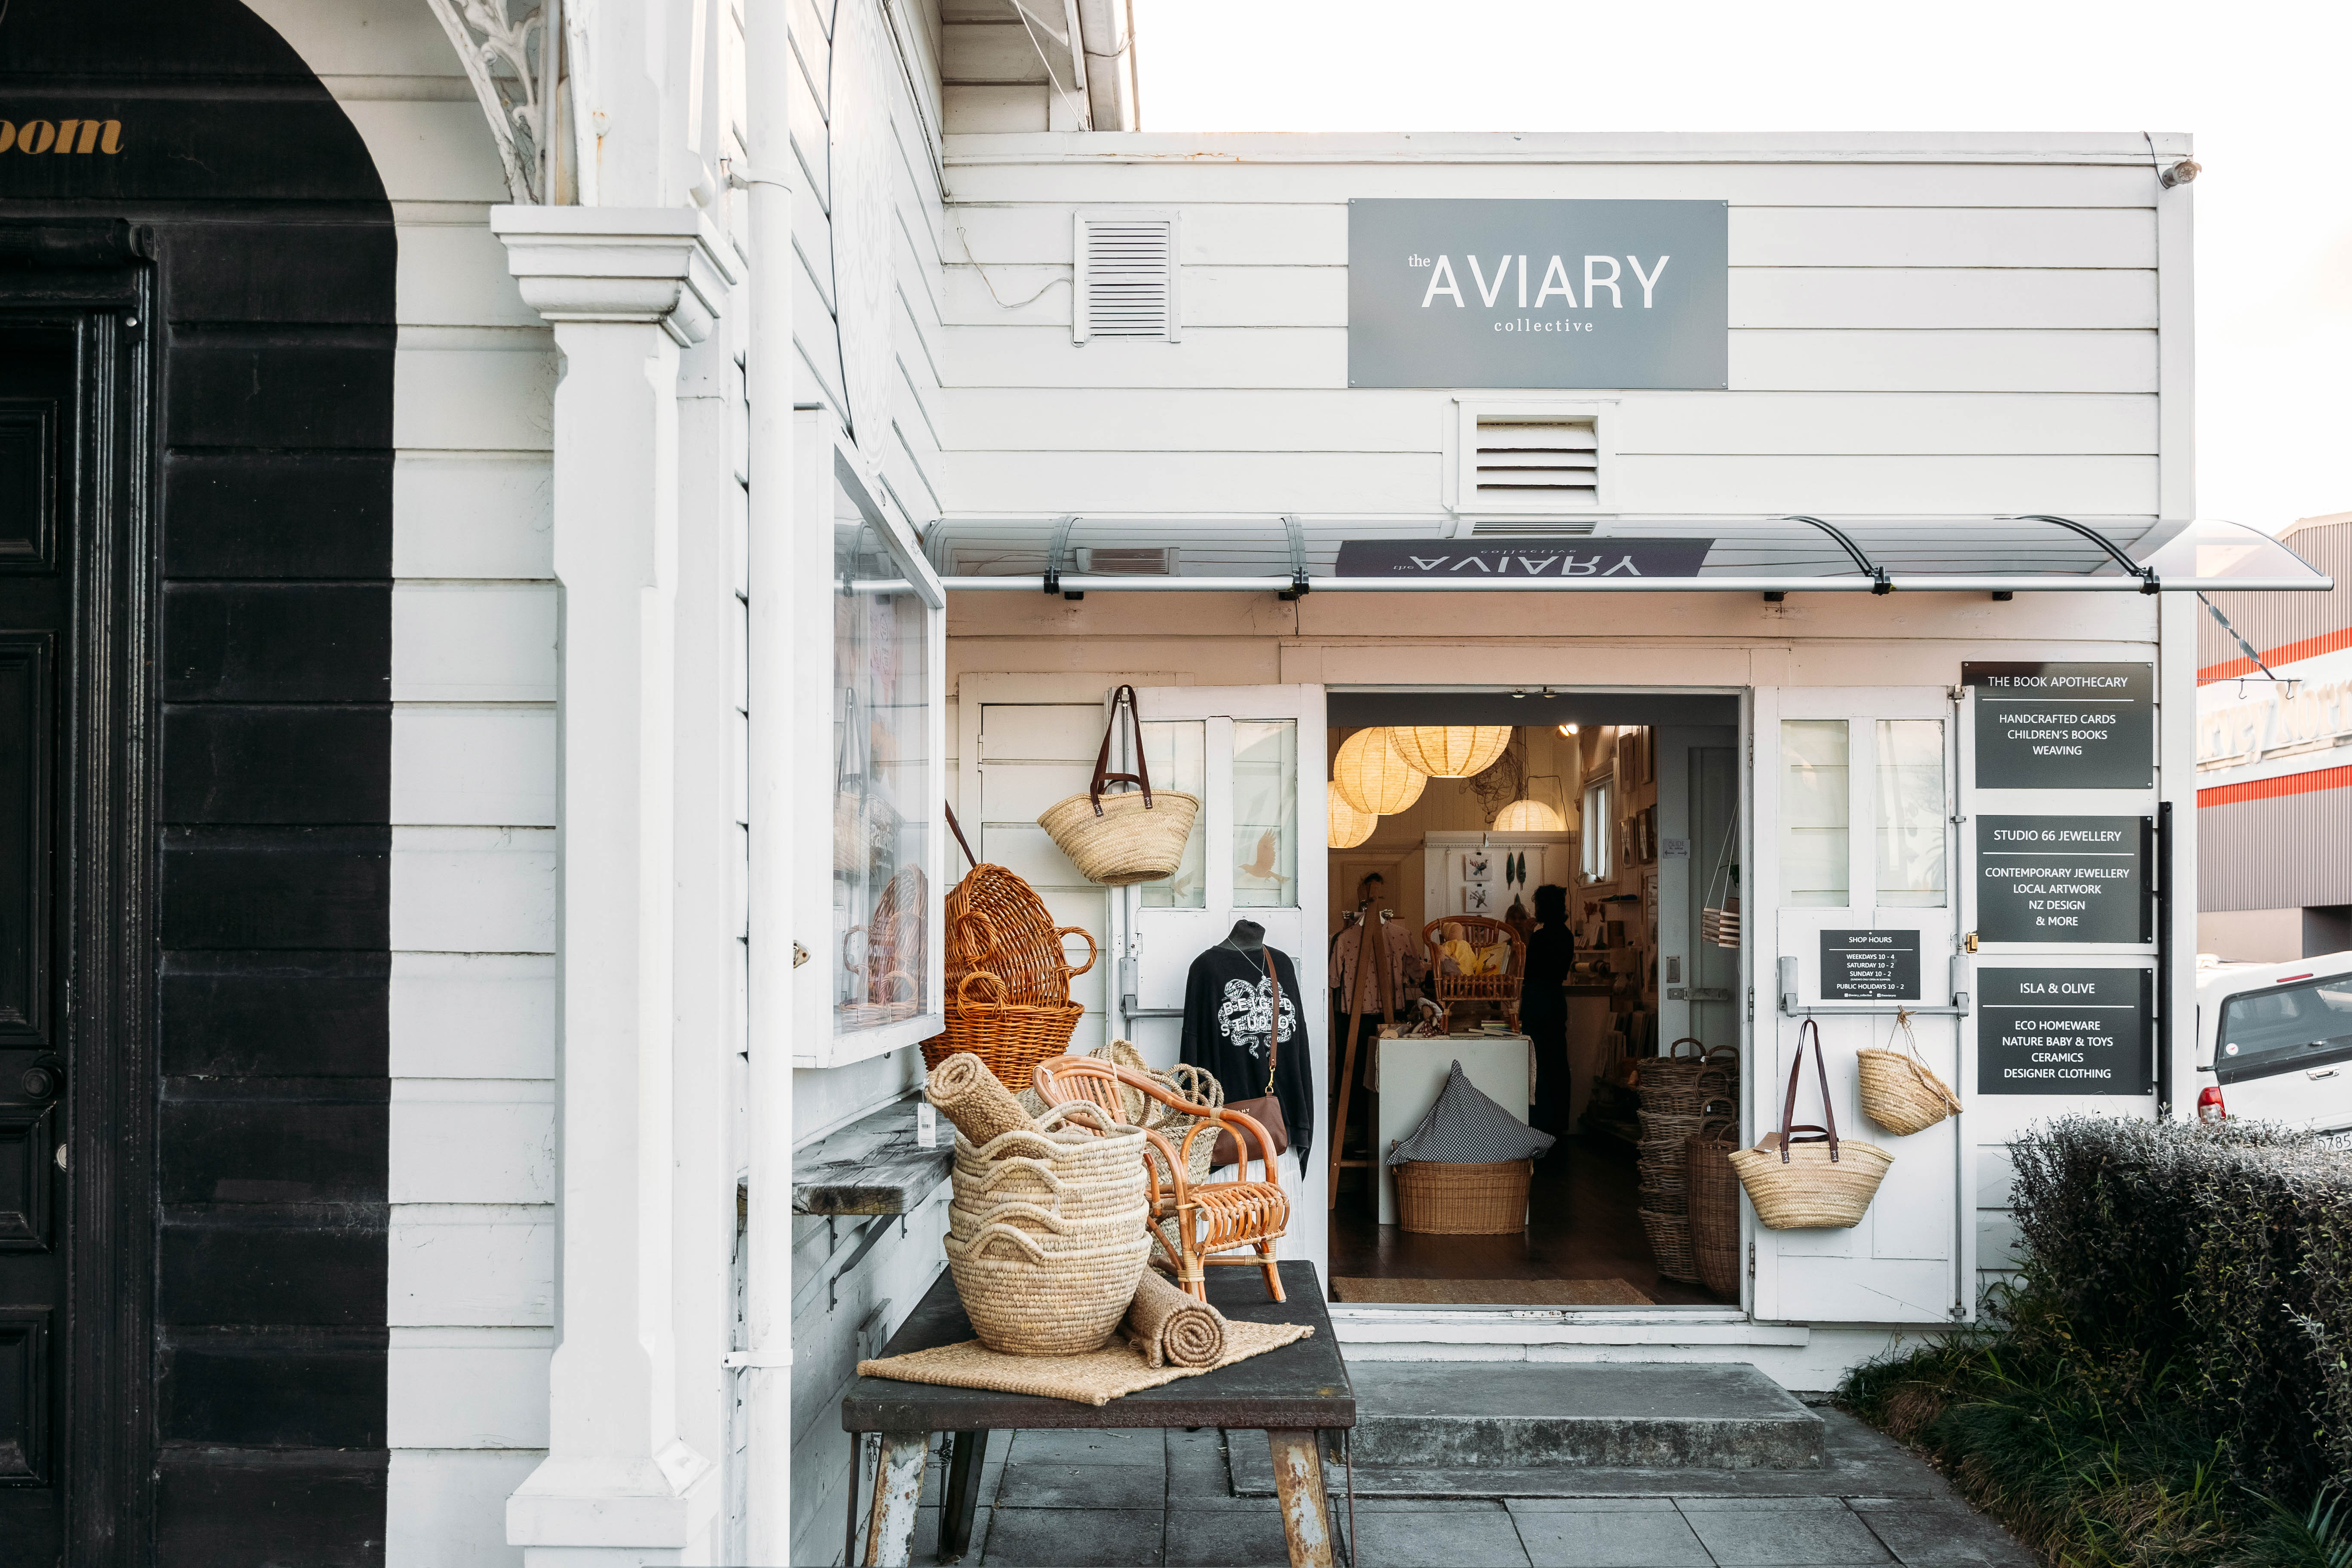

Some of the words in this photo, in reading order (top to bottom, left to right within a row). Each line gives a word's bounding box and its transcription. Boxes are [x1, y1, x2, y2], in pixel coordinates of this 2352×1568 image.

[1409, 254, 1430, 266] the
[1421, 254, 1669, 308] AVIARY
[1494, 319, 1592, 331] collective
[1988, 677, 2009, 686] THE
[2014, 677, 2047, 686] BOOK
[2051, 677, 2128, 687] APOTHECARY
[2000, 714, 2077, 723] HANDCRAFTED
[2081, 715, 2116, 723] CARDS
[2008, 730, 2068, 739] CHILDREN'S
[2072, 730, 2107, 739] BOOKS
[2033, 746, 2082, 755] WEAVING
[1994, 830, 2038, 840] STUDIO
[2042, 831, 2055, 840] 66
[2058, 831, 2121, 841] JEWELLERY
[1985, 868, 2071, 877] CONTEMPORARY
[2074, 869, 2129, 878] JEWELLERY
[2014, 884, 2046, 893] LOCAL
[2049, 885, 2101, 894] ARTWORK
[2029, 900, 2044, 909] NZ
[2047, 900, 2085, 910] DESIGN
[2036, 916, 2045, 925] &
[2049, 917, 2078, 925] MORE
[2021, 983, 2045, 993] ISLA
[2049, 983, 2058, 993] &
[2062, 983, 2095, 993] OLIVE
[1223, 997, 1292, 1016] BEIGD
[2015, 1021, 2036, 1030] ECO
[2040, 1021, 2100, 1030] HOMEWARE
[2003, 1037, 2043, 1046] NATURE
[2047, 1037, 2072, 1046] BABY
[2075, 1037, 2084, 1046] &
[2087, 1037, 2113, 1046] TOYS
[2032, 1053, 2083, 1062] CERAMICS
[2005, 1069, 2055, 1078] DESIGNER
[2058, 1069, 2110, 1078] CLOTHING
